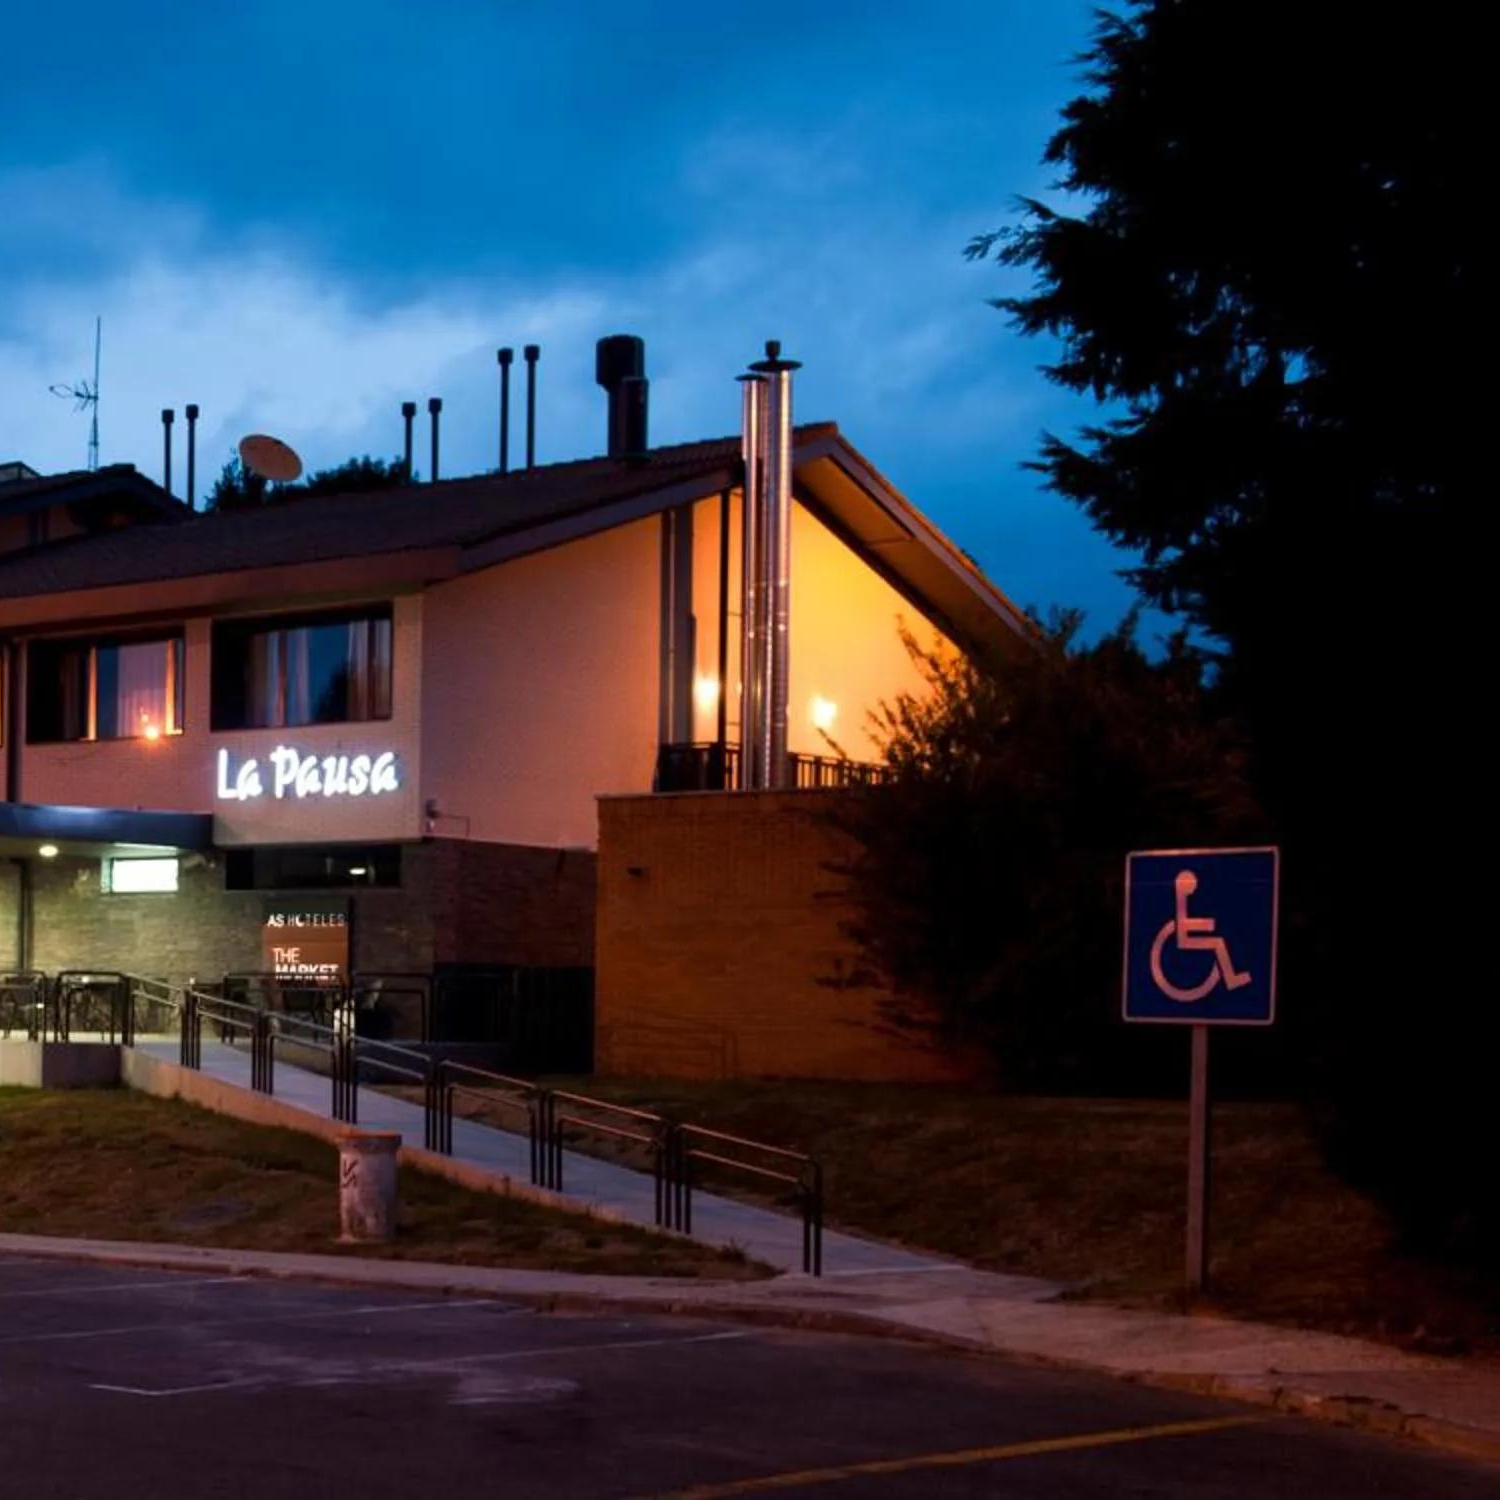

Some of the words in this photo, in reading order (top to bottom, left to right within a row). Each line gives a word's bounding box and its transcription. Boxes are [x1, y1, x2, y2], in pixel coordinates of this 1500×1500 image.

[217, 748, 263, 800] La
[270, 745, 399, 798] Pausa
[267, 913, 285, 928] AS
[272, 947, 300, 963] THE
[275, 963, 339, 980] MARKET
